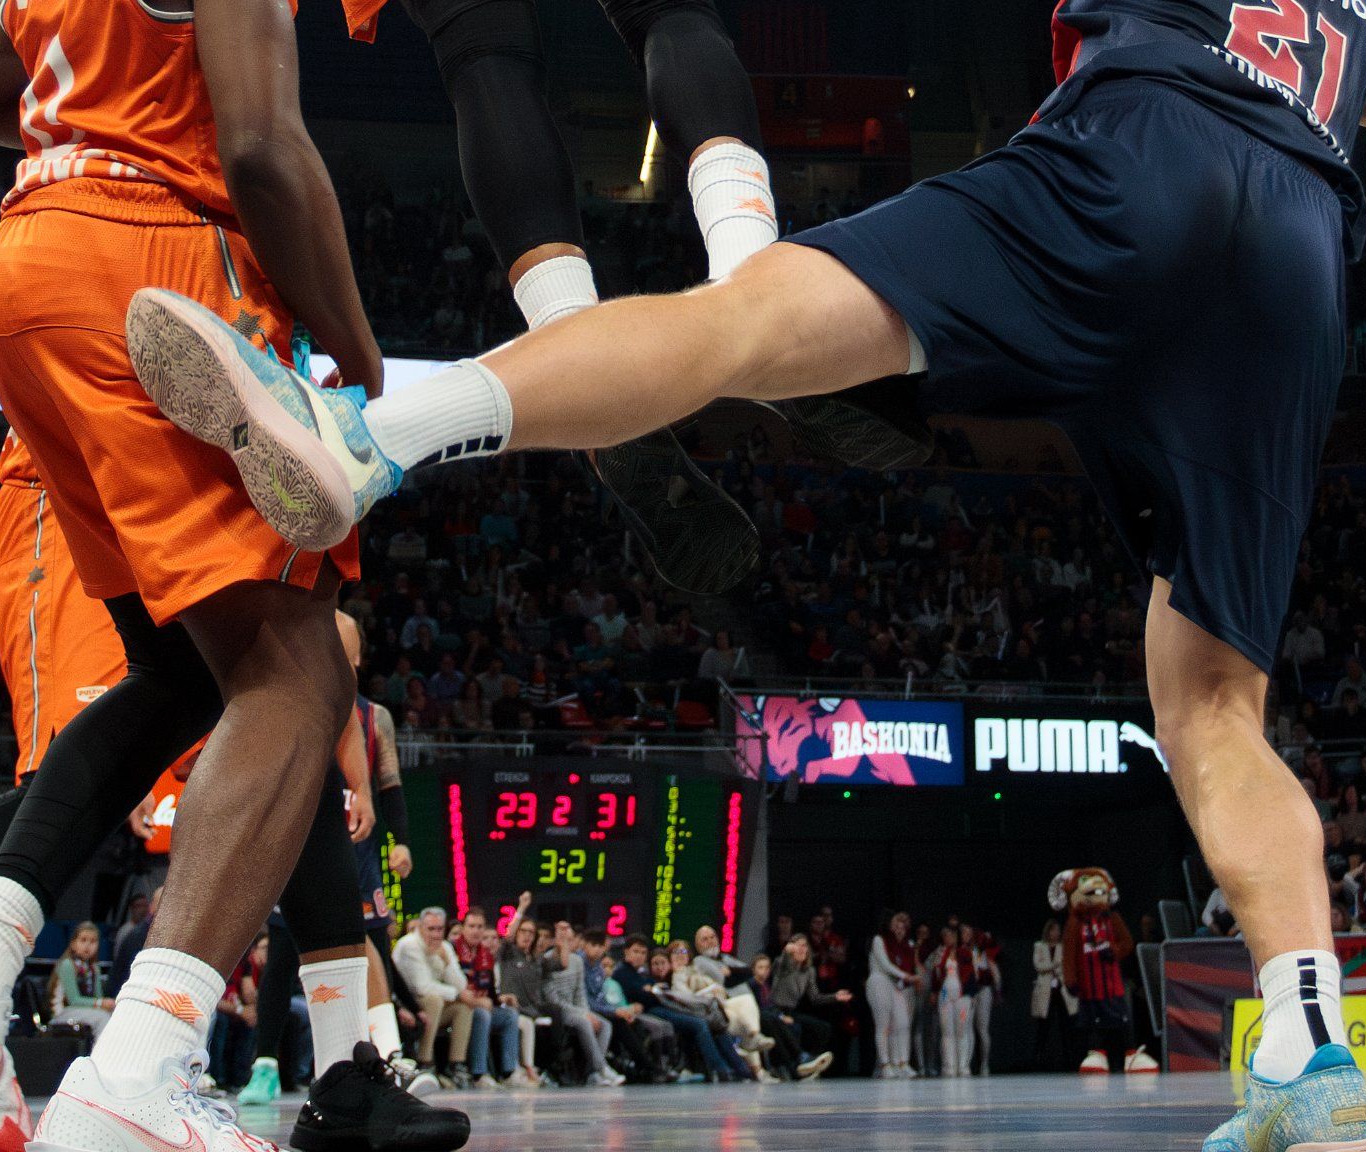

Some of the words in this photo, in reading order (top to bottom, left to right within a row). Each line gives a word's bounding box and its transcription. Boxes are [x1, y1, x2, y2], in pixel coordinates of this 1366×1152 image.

[832, 721, 952, 765] BASKONIA
[975, 717, 1119, 773] PUMA
[496, 791, 538, 829] 23
[552, 795, 572, 826] 2
[596, 792, 636, 829] 31
[539, 849, 606, 884] 3:21
[606, 905, 627, 937] 2
